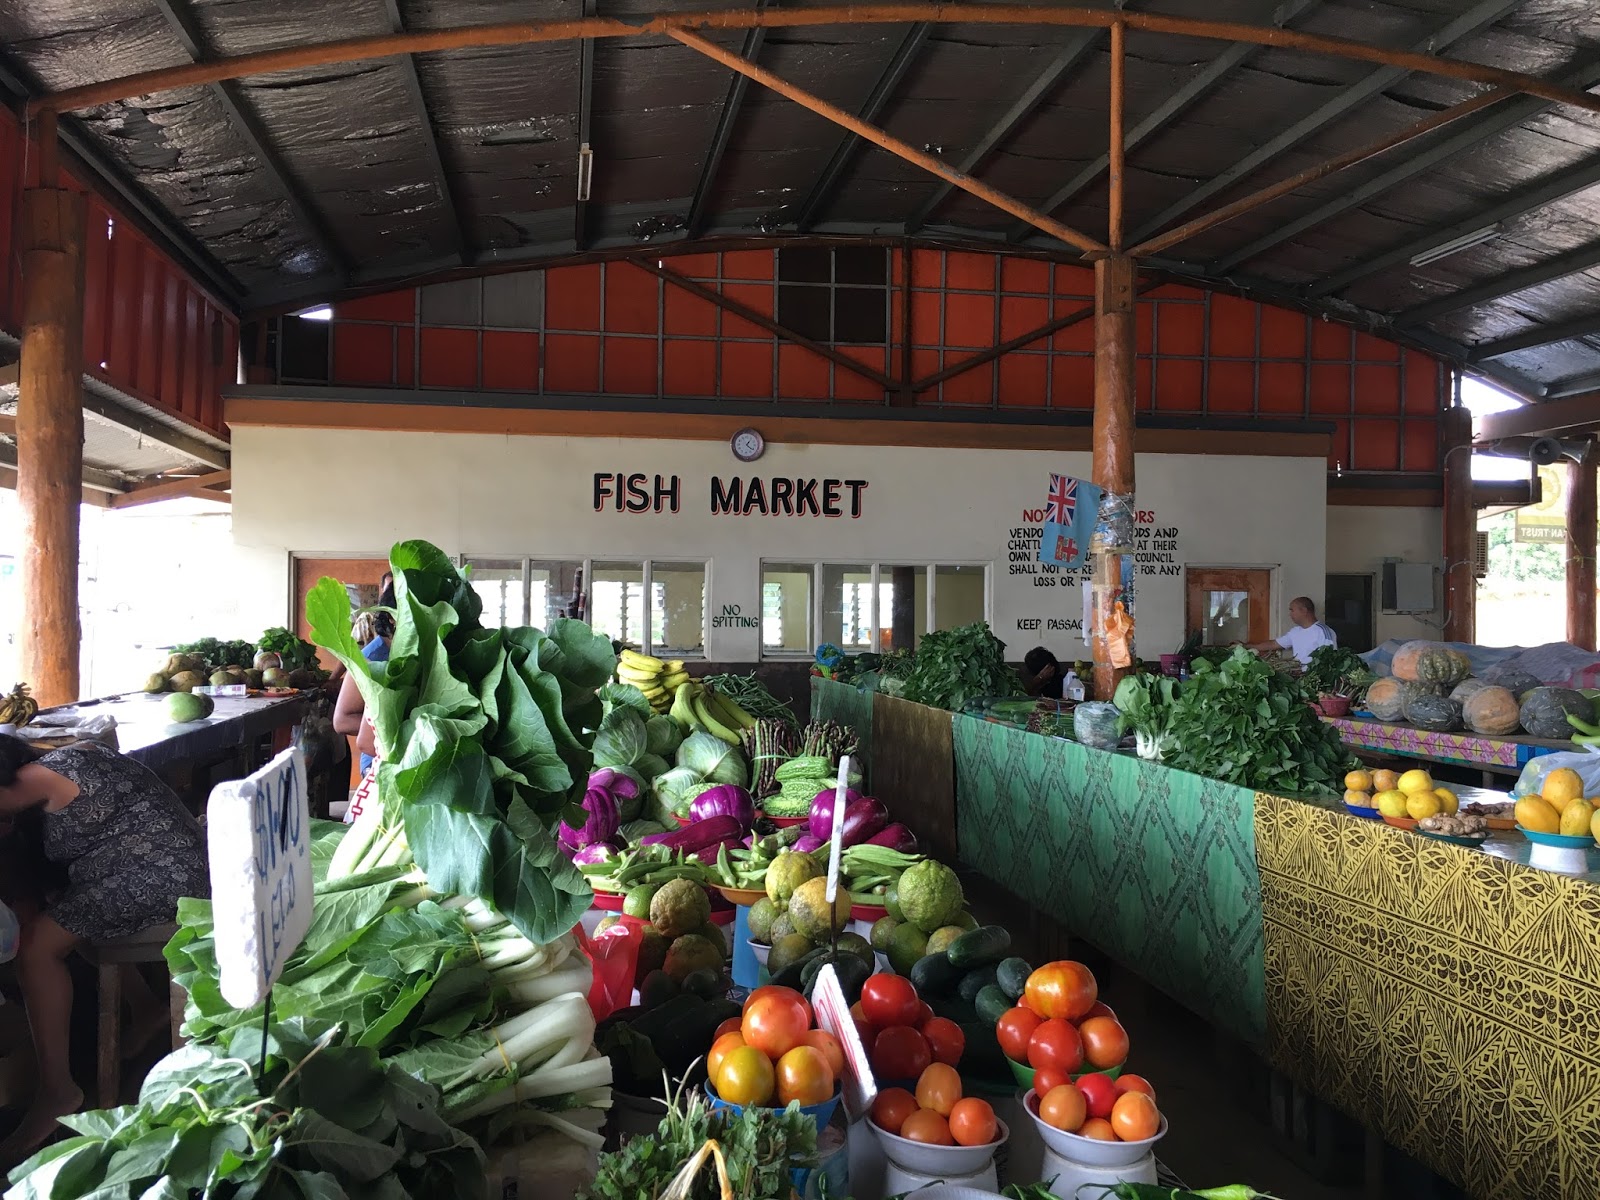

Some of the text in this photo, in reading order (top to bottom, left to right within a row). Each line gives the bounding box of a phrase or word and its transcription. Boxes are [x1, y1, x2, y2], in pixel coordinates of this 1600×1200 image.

[593, 473, 868, 518] FISH MARKET
[1023, 509, 1046, 522] NO
[1009, 527, 1044, 539] VENDO
[1154, 527, 1178, 538] AND
[1008, 539, 1177, 551] CHATT AT THEIR
[1008, 551, 1030, 562] OWN
[1135, 552, 1174, 563] COUNCIL
[1009, 564, 1037, 575] SHALL
[1042, 564, 1059, 574] NOT
[1141, 564, 1156, 575] FOR
[1159, 564, 1181, 576] ANY
[1033, 576, 1056, 587] LOSS
[1060, 576, 1075, 587] OR
[722, 604, 741, 616] NO
[712, 616, 759, 628] SPITTING
[1017, 618, 1042, 630] KEEP
